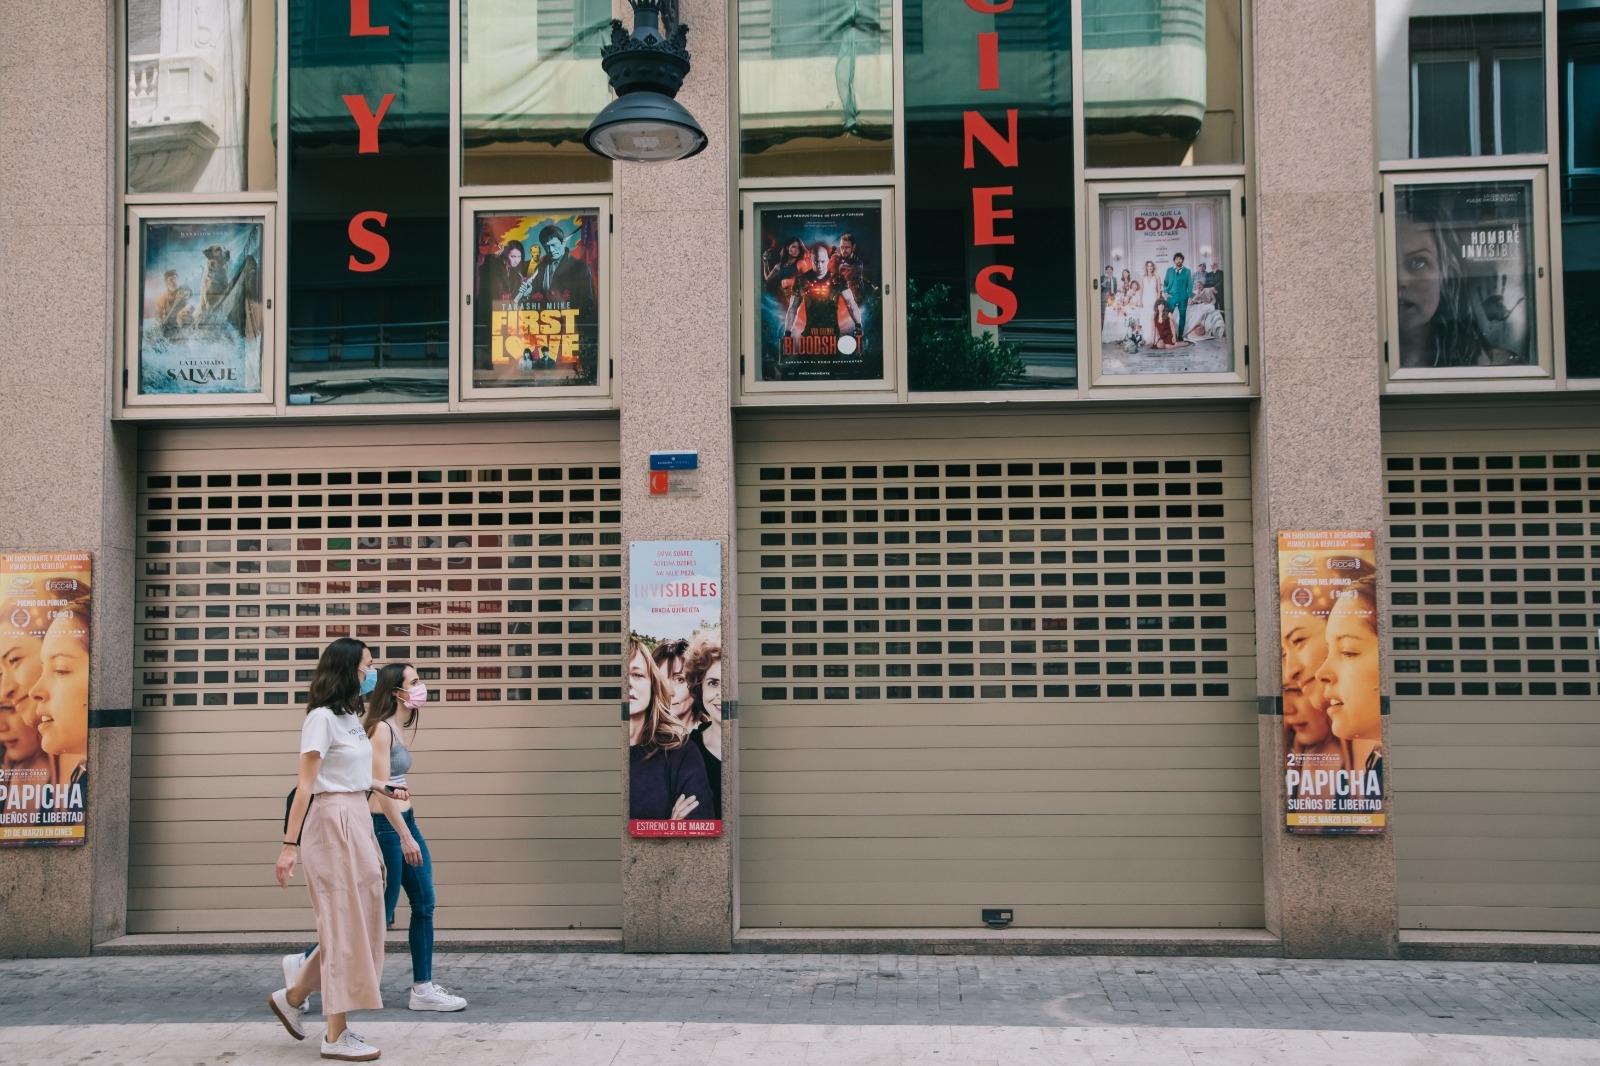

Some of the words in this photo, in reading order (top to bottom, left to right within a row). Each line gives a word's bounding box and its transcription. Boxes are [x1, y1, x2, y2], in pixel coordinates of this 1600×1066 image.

[963, 0, 1018, 325] INES
[1134, 215, 1188, 231] BODA
[1470, 229, 1521, 245] HOMBRE
[1461, 243, 1519, 259] INVISIB
[501, 302, 541, 311] TAKASHI
[546, 301, 571, 310] MIIKE
[492, 308, 580, 336] FIRST
[167, 367, 238, 385] SALVAJE
[634, 582, 717, 598] INVISIBLES
[1286, 753, 1296, 767] 2
[1286, 769, 1381, 796] PAPICHA
[1288, 796, 1323, 810] SUEÑOS
[1324, 798, 1337, 810] DE
[1338, 798, 1382, 811] LIBERTAD
[0, 811, 28, 824] UEÑOS
[29, 812, 41, 824] DE
[42, 811, 83, 823] LIBERTAD
[1298, 815, 1307, 824] 20
[1308, 815, 1318, 824] DE
[1318, 815, 1341, 824] MARZO
[1342, 815, 1352, 824] EN
[1352, 815, 1372, 824] CINES
[3, 829, 12, 838] 20
[13, 829, 21, 837] DE
[22, 828, 44, 837] MARZO
[45, 828, 54, 836] EN
[54, 827, 73, 836] CINES
[636, 821, 669, 831] ESTRENO
[670, 821, 676, 831] 6
[677, 821, 687, 831] DE
[688, 821, 715, 831] MARZO
